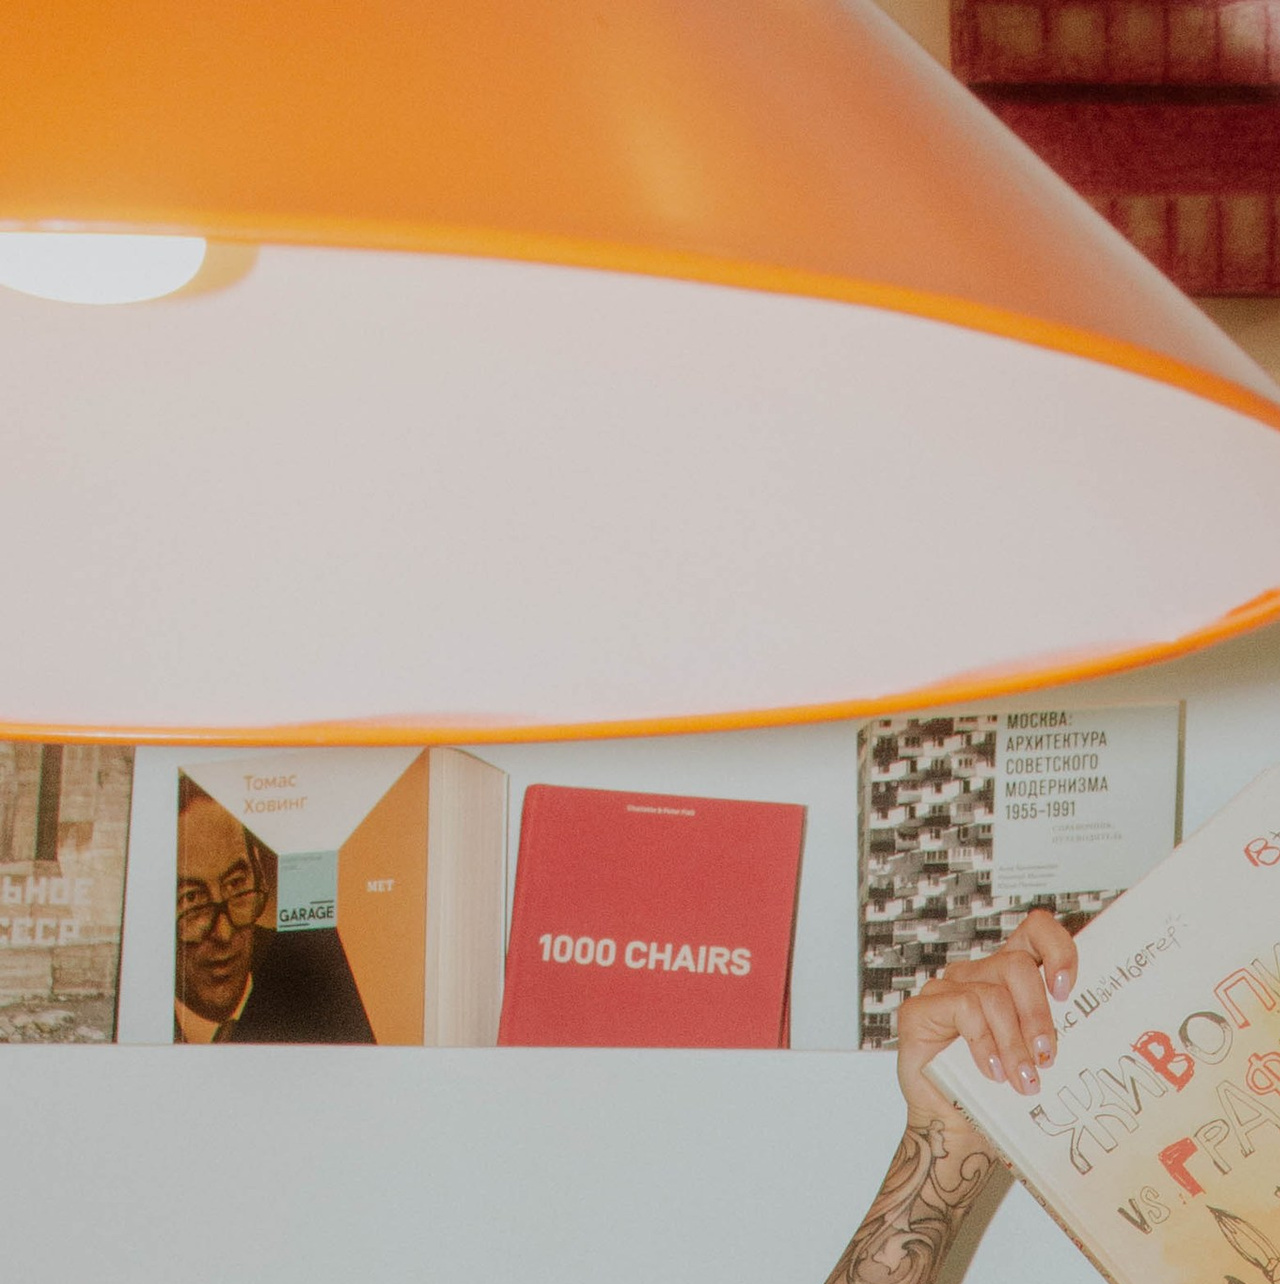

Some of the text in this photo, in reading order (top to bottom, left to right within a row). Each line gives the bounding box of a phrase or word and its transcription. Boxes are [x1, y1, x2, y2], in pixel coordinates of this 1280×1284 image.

[1006, 710, 1073, 730] МОСКВА:
[1005, 731, 1108, 752] АРХИТЕКТУРА
[1005, 753, 1099, 776] СОВЕТСКОГО
[243, 774, 297, 792] Томас
[1005, 776, 1109, 799] МОДЕРНИЗМА
[243, 795, 308, 815] Ховинг
[279, 905, 335, 923] GARAGE
[539, 933, 752, 976] 1000 CHAIRS
